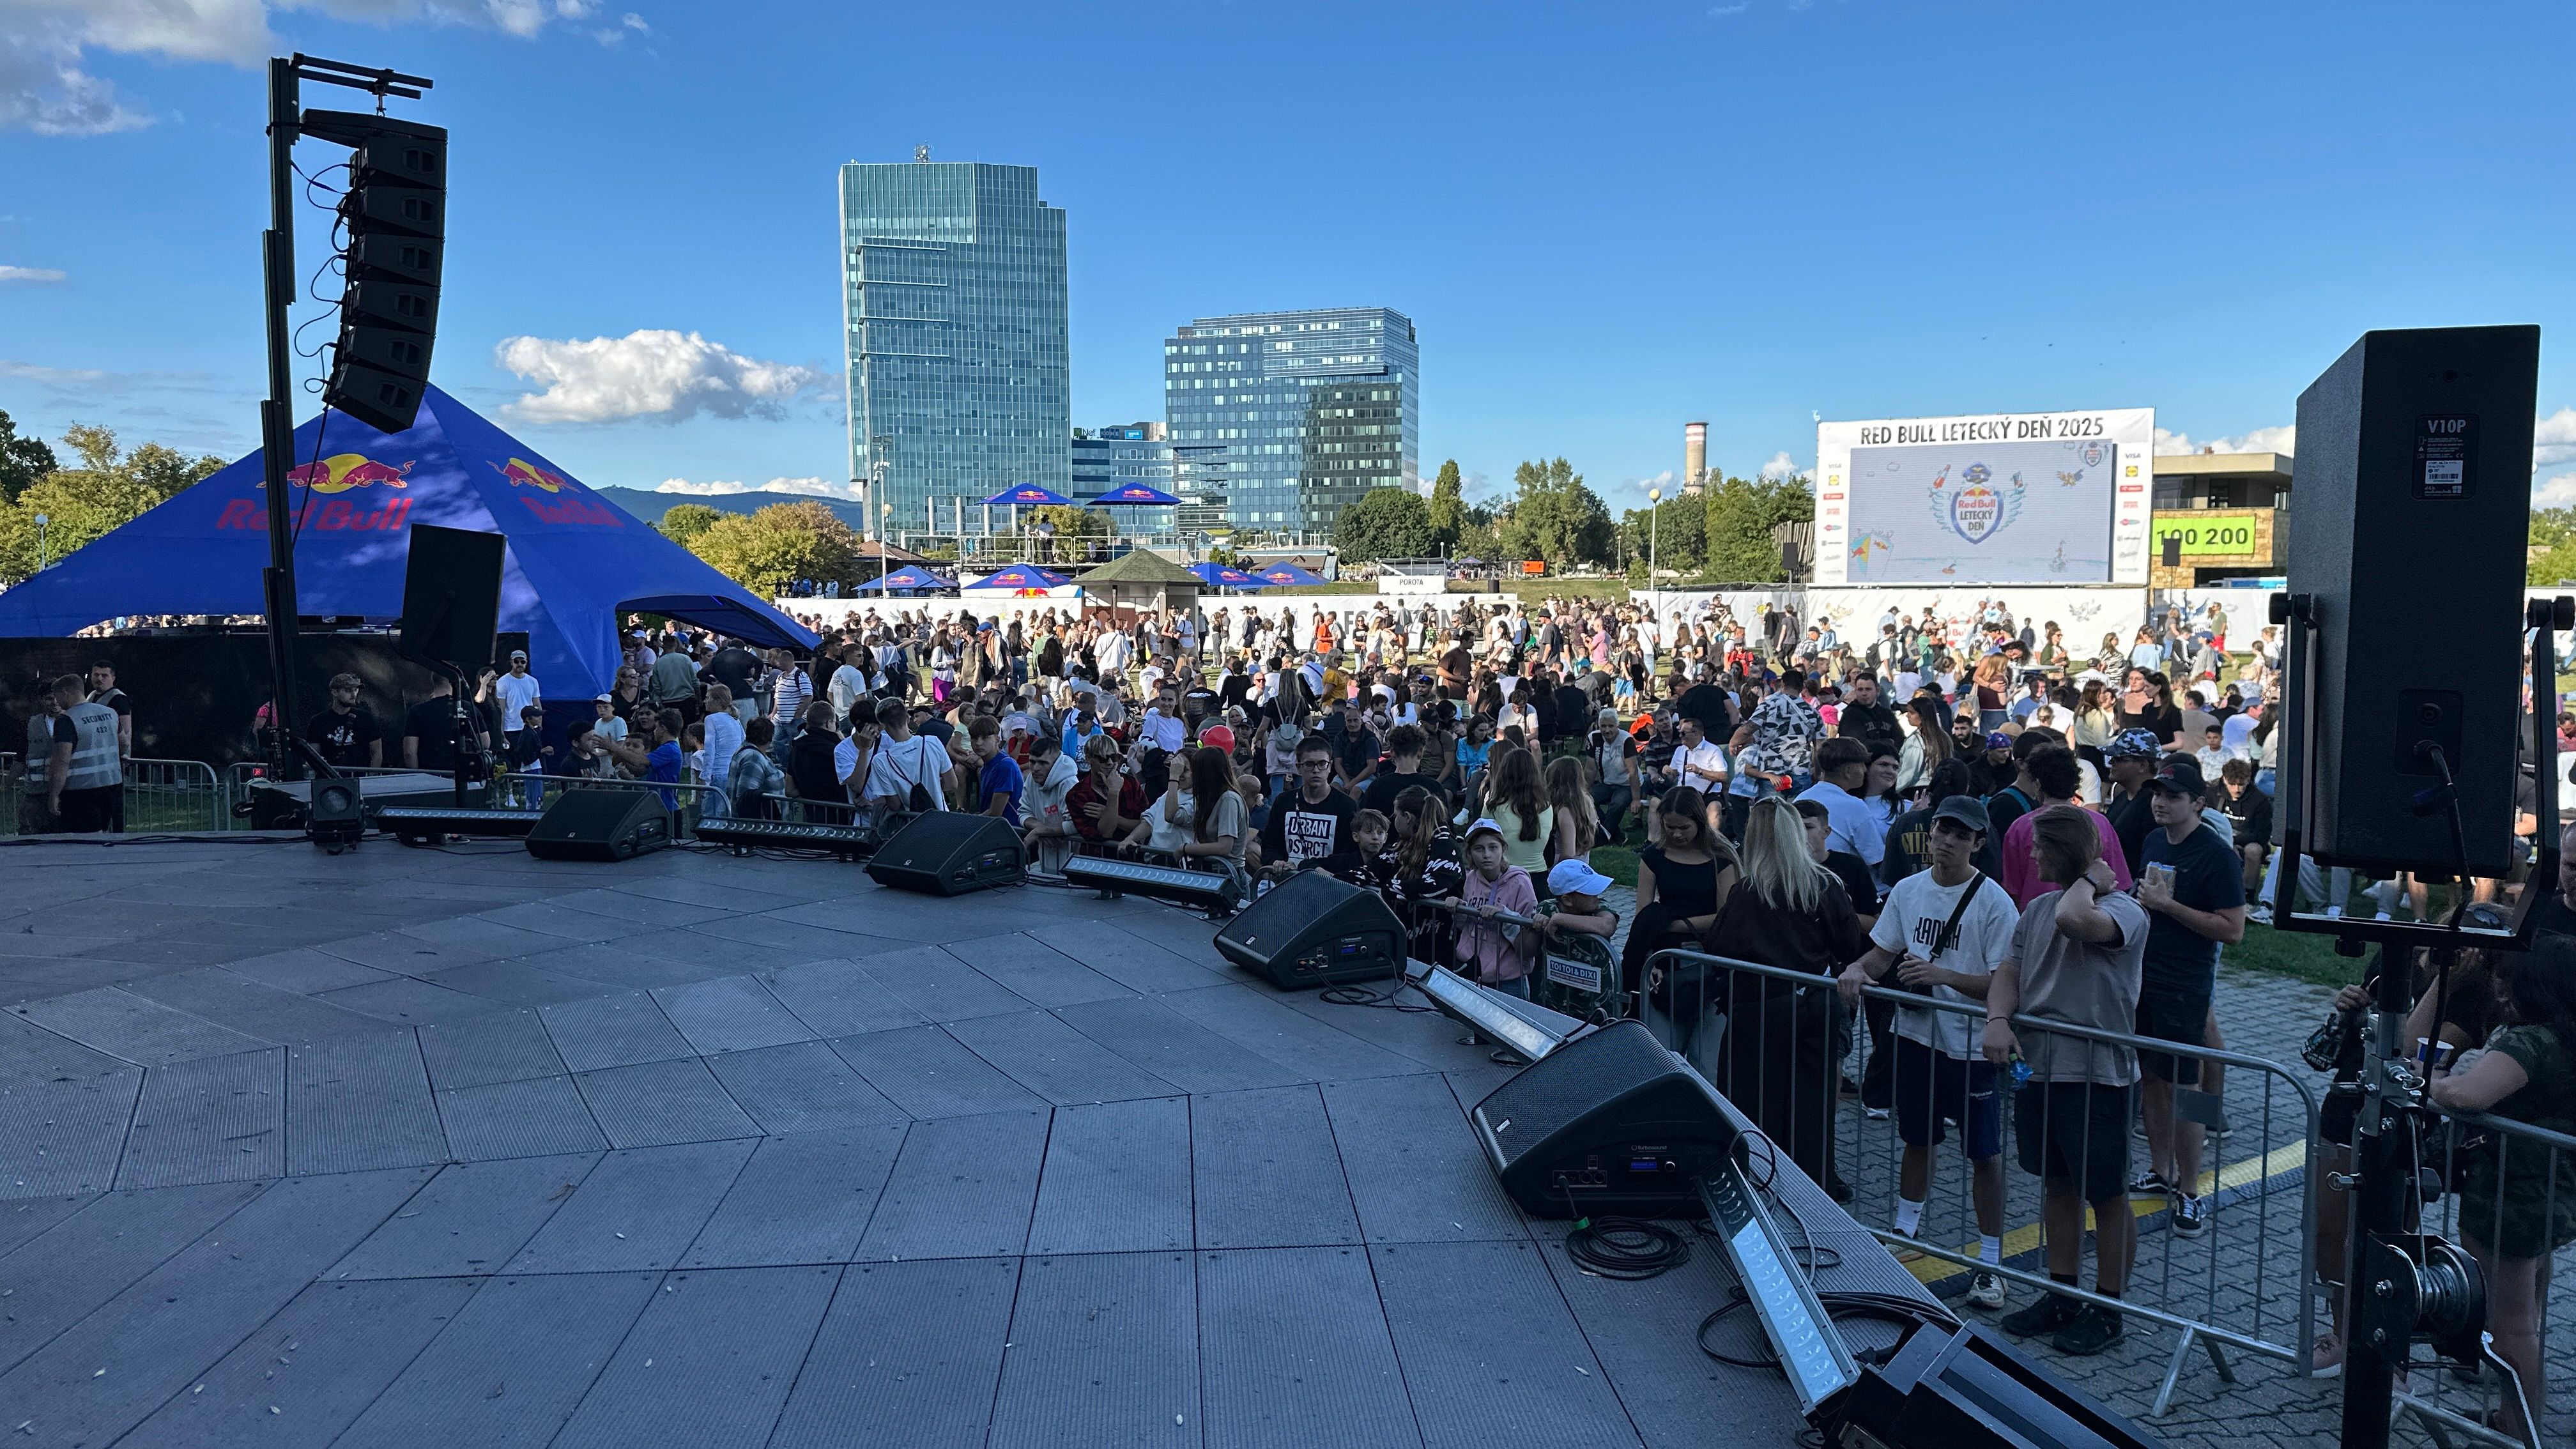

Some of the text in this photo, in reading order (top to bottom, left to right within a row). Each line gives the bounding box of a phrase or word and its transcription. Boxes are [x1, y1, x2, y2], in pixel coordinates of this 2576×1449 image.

[1860, 416, 2102, 445] RED BULL LETECKÝ DEŇ 2025
[2427, 419, 2466, 433] V10P
[1958, 499, 1995, 509] Red Bull
[314, 497, 414, 531] Bull
[1960, 509, 1993, 520] LETECKÝ
[1968, 520, 1984, 531] DEŇ
[2205, 527, 2249, 546] 200
[81, 713, 112, 724] SECURITY
[1291, 818, 1328, 837] URBAN
[1551, 962, 1561, 971] TOI
[1562, 965, 1574, 974] TOI
[1580, 969, 1596, 980] DIXI
